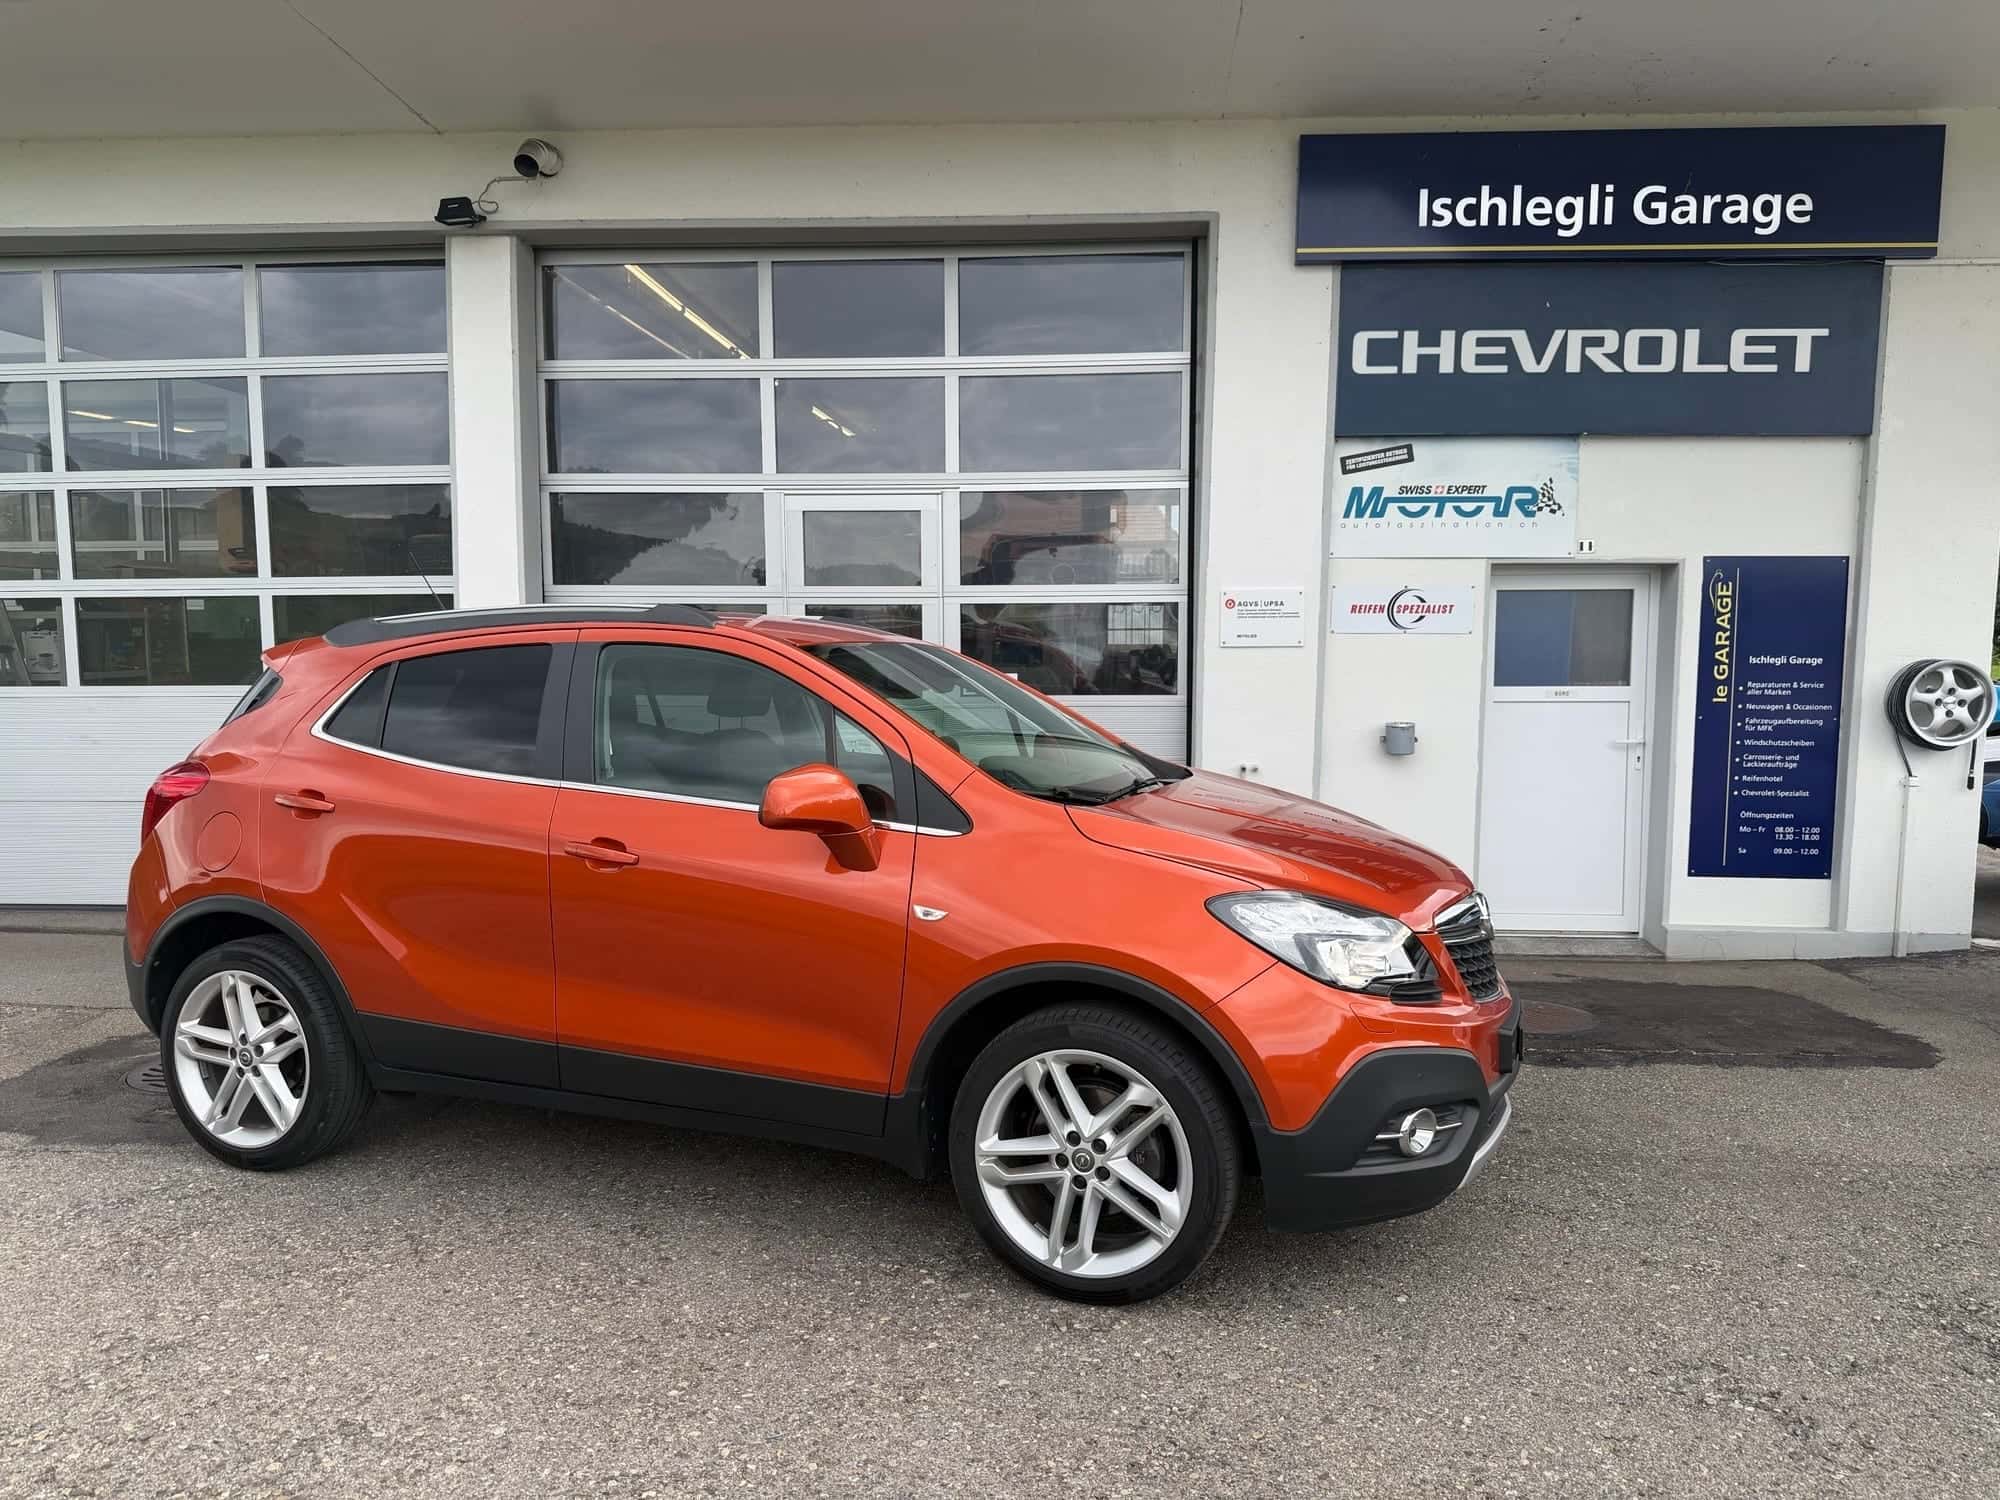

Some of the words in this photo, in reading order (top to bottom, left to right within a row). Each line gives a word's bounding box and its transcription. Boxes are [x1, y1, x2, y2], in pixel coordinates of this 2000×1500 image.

[1418, 183, 1614, 237] Ischlegli
[1632, 185, 1814, 236] Garage
[1351, 328, 1829, 374] CHEVROLET
[1398, 485, 1432, 495] SWISS
[1446, 485, 1487, 495] EXPERT
[1237, 600, 1259, 608] AGVS
[1263, 600, 1285, 608] UPSA
[1350, 604, 1385, 614] REIFEN
[1395, 604, 1455, 615] SPEZIALIST
[1713, 581, 1733, 679] GARAGE
[1749, 655, 1787, 666] Ischlegli
[1789, 655, 1824, 666] Garage
[1747, 681, 1791, 689] Reparaturen
[1800, 681, 1825, 689] Service
[1712, 685, 1728, 702] le
[1745, 703, 1784, 711] Neuwagen
[1792, 703, 1833, 711] Occasionen
[1745, 717, 1824, 727] Fahrzeugaufbereitung
[1743, 739, 1815, 747] Windschutzscheiben
[1743, 753, 1785, 761] Carrosserie-
[1743, 761, 1798, 770] Lackieraufträge
[1740, 810, 1795, 820] Öffnungszeiten
[1739, 825, 1752, 833] Mo
[1758, 825, 1766, 833] Fr
[1773, 847, 1793, 855] 09.00
